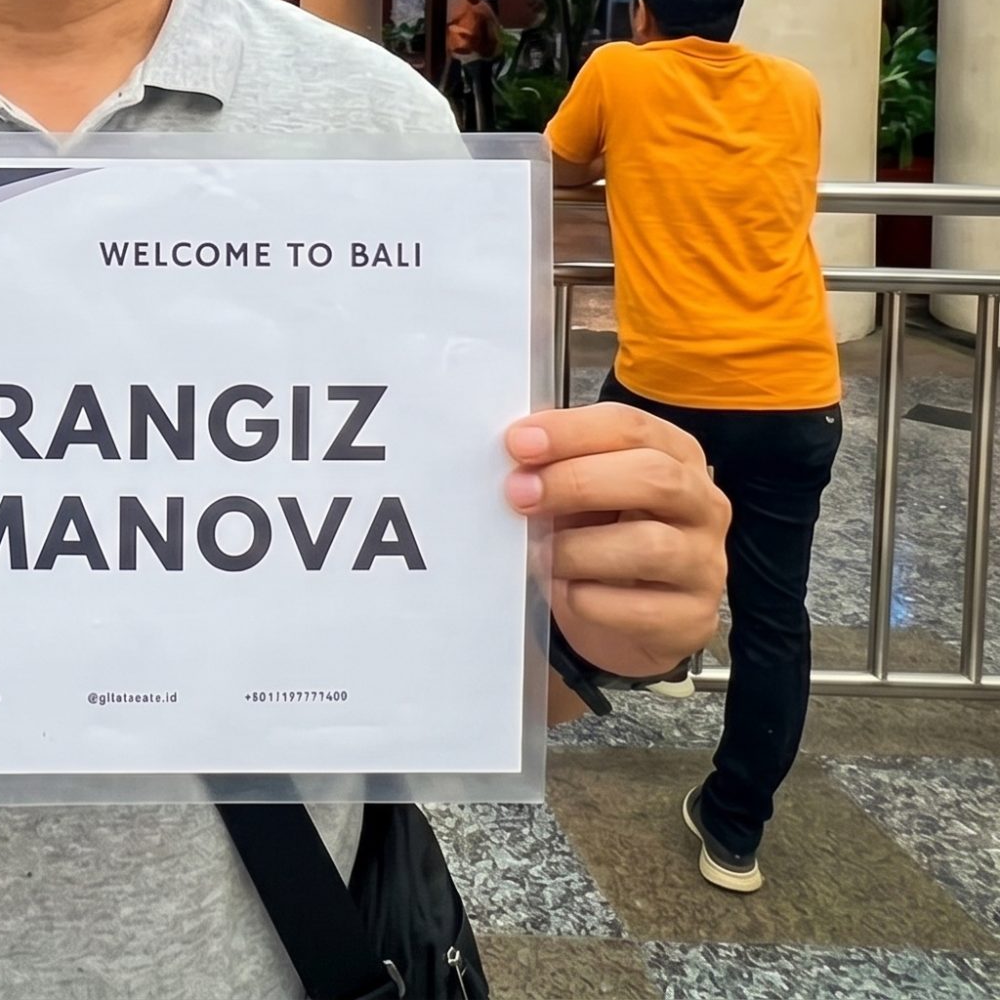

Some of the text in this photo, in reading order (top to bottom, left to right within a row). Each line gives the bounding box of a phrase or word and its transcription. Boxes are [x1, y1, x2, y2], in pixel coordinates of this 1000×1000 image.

[99, 242, 421, 267] WELCOME TO BALI
